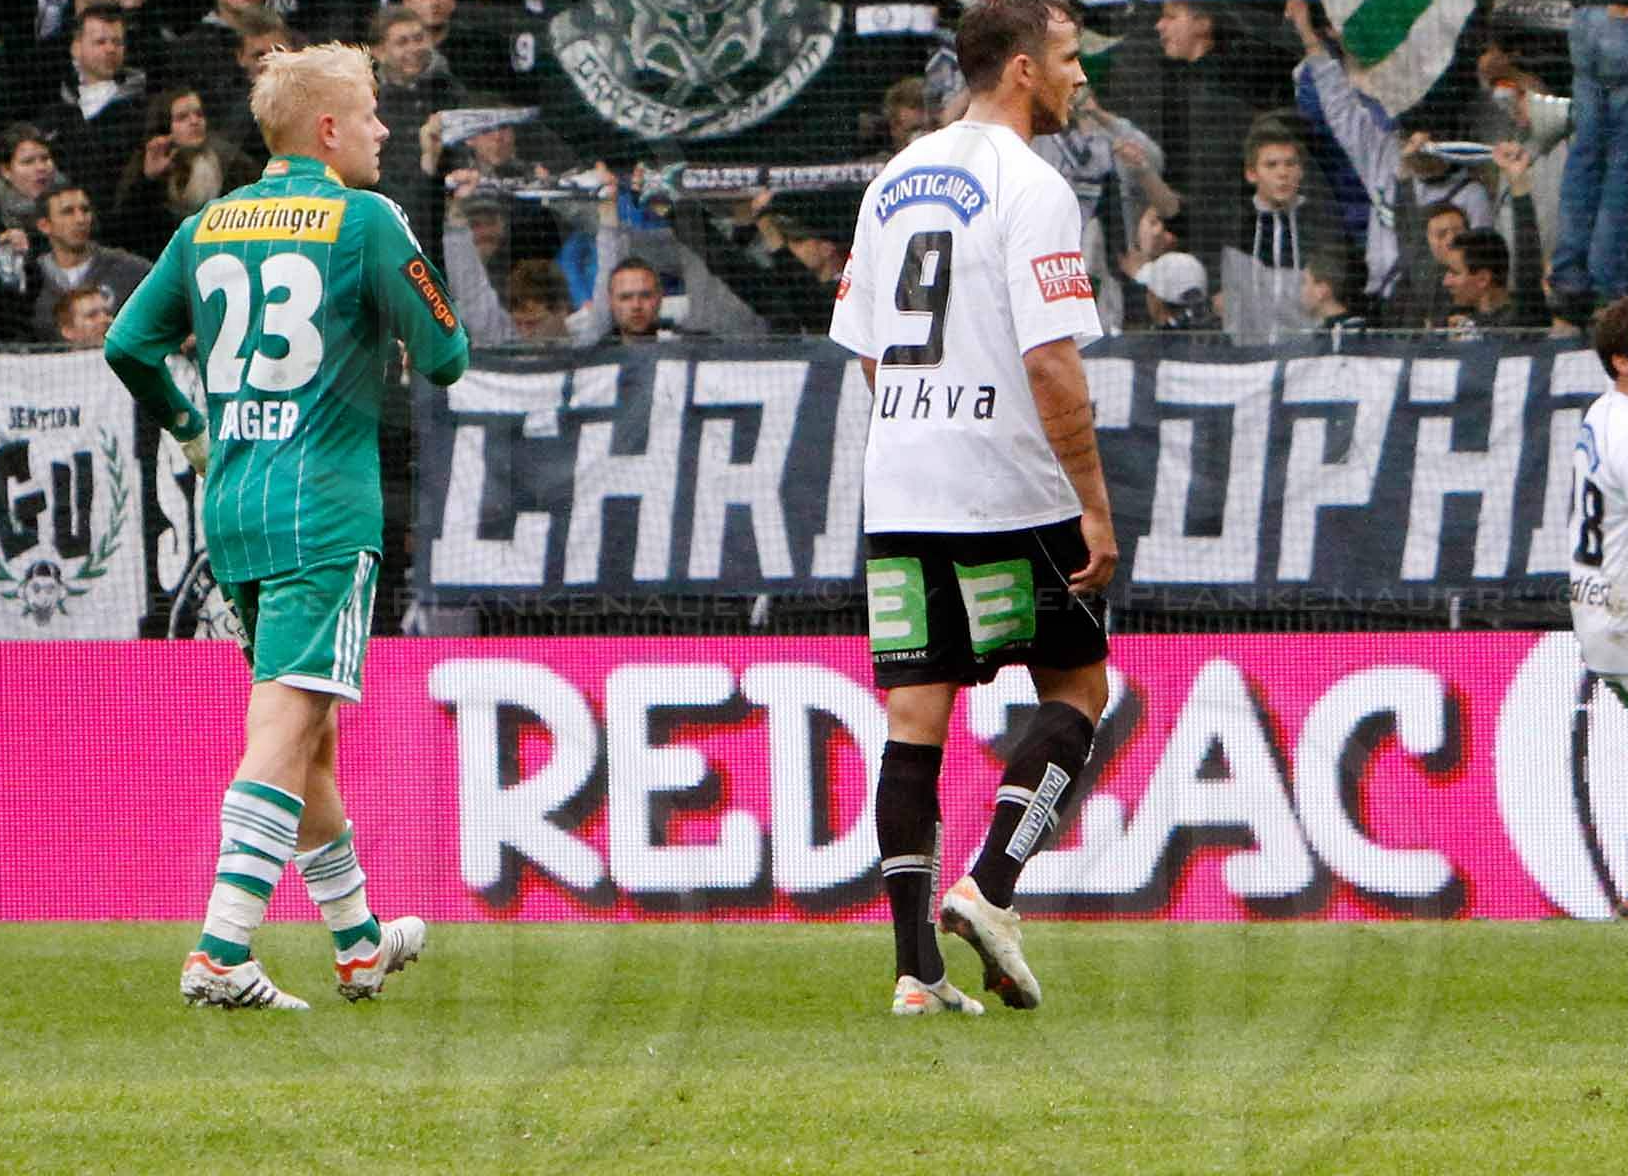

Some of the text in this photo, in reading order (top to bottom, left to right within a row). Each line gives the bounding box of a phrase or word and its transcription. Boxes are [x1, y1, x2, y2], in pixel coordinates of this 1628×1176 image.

[206, 202, 330, 234] Ottakringer
[877, 173, 982, 218] PUNTIGAMER
[195, 251, 324, 394] 23
[408, 260, 457, 330] Orange
[879, 229, 954, 370] 9
[427, 657, 1460, 898] RED ZAC
